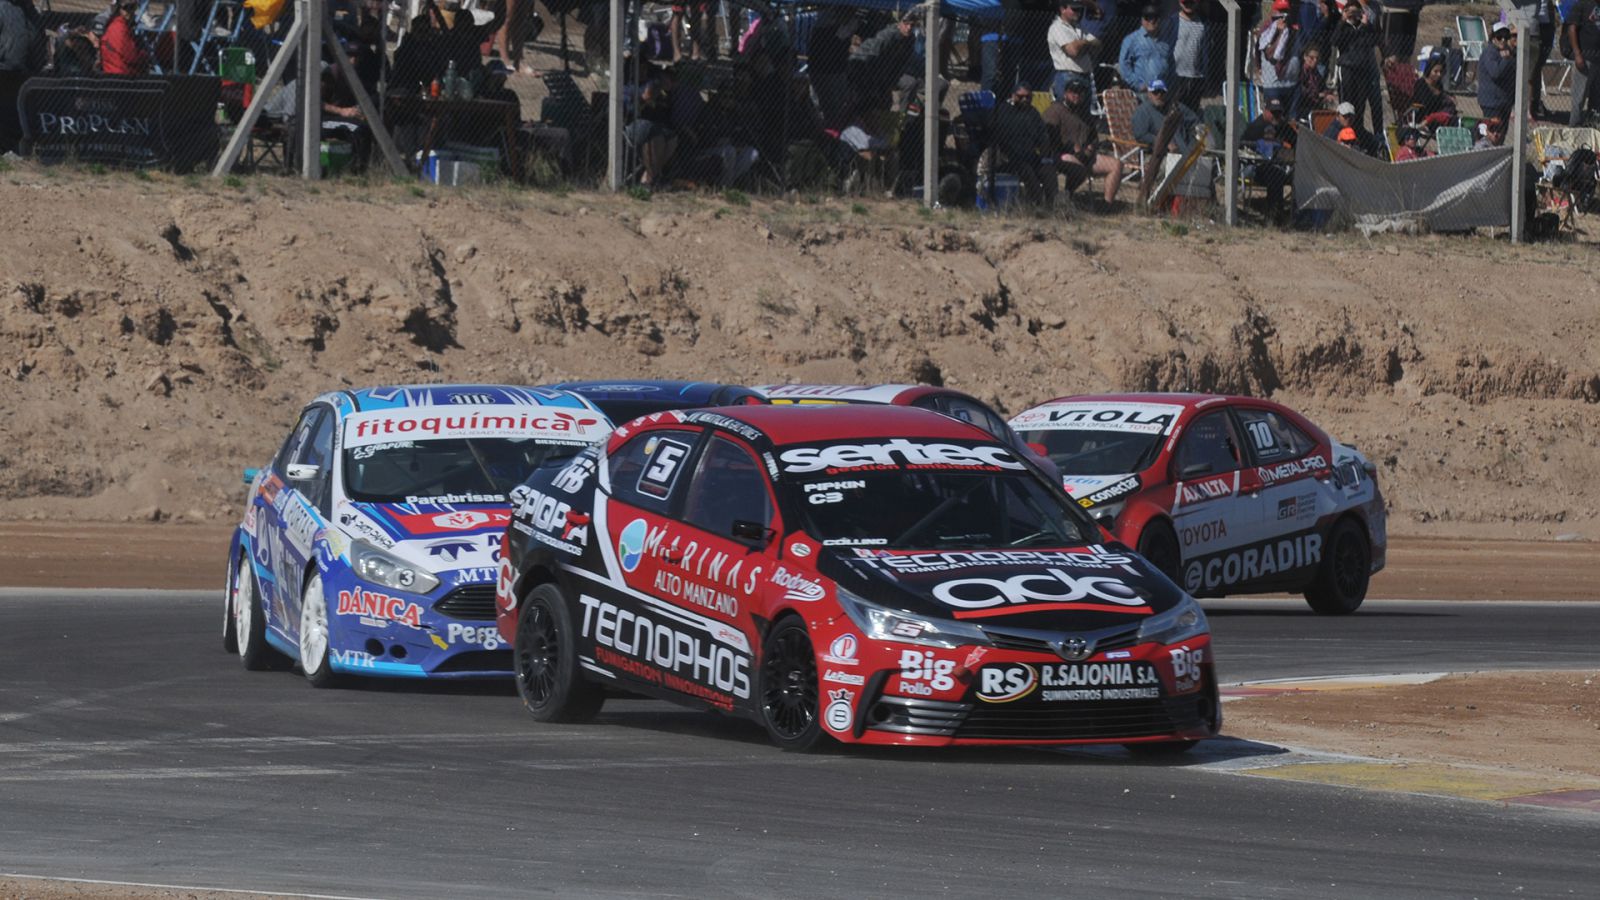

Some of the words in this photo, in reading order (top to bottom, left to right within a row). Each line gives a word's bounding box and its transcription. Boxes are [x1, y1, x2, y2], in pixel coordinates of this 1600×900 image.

[356, 411, 570, 437] fitoquímica
[1129, 424, 1162, 432] TOYOT
[1249, 422, 1274, 449] 10
[646, 445, 685, 483] 5
[1269, 455, 1327, 480] METALPRO
[804, 480, 865, 493] PIPKIN
[1090, 477, 1139, 502] conectar
[405, 493, 505, 505] Parabrisas
[808, 492, 843, 505] C3
[851, 552, 1133, 569] TECNOPHOS
[897, 560, 998, 574] FUMIGATION
[1001, 559, 1112, 570] INNOVATIONS
[401, 570, 414, 585] 3
[458, 567, 499, 583] MT
[654, 570, 682, 596] ALTO
[683, 581, 739, 618] MANZANO
[893, 622, 923, 637] 5
[579, 594, 751, 700] TECNOPHOS
[898, 650, 956, 691] Big
[1169, 645, 1203, 681] Big
[982, 667, 1025, 695] RS
[1041, 663, 1133, 686] R.SAJONIA
[1136, 666, 1159, 684] S.A.
[900, 681, 932, 696] Pollo
[1042, 689, 1101, 701] SUMINISTROS
[1103, 687, 1160, 700] INDUSTRIALES
